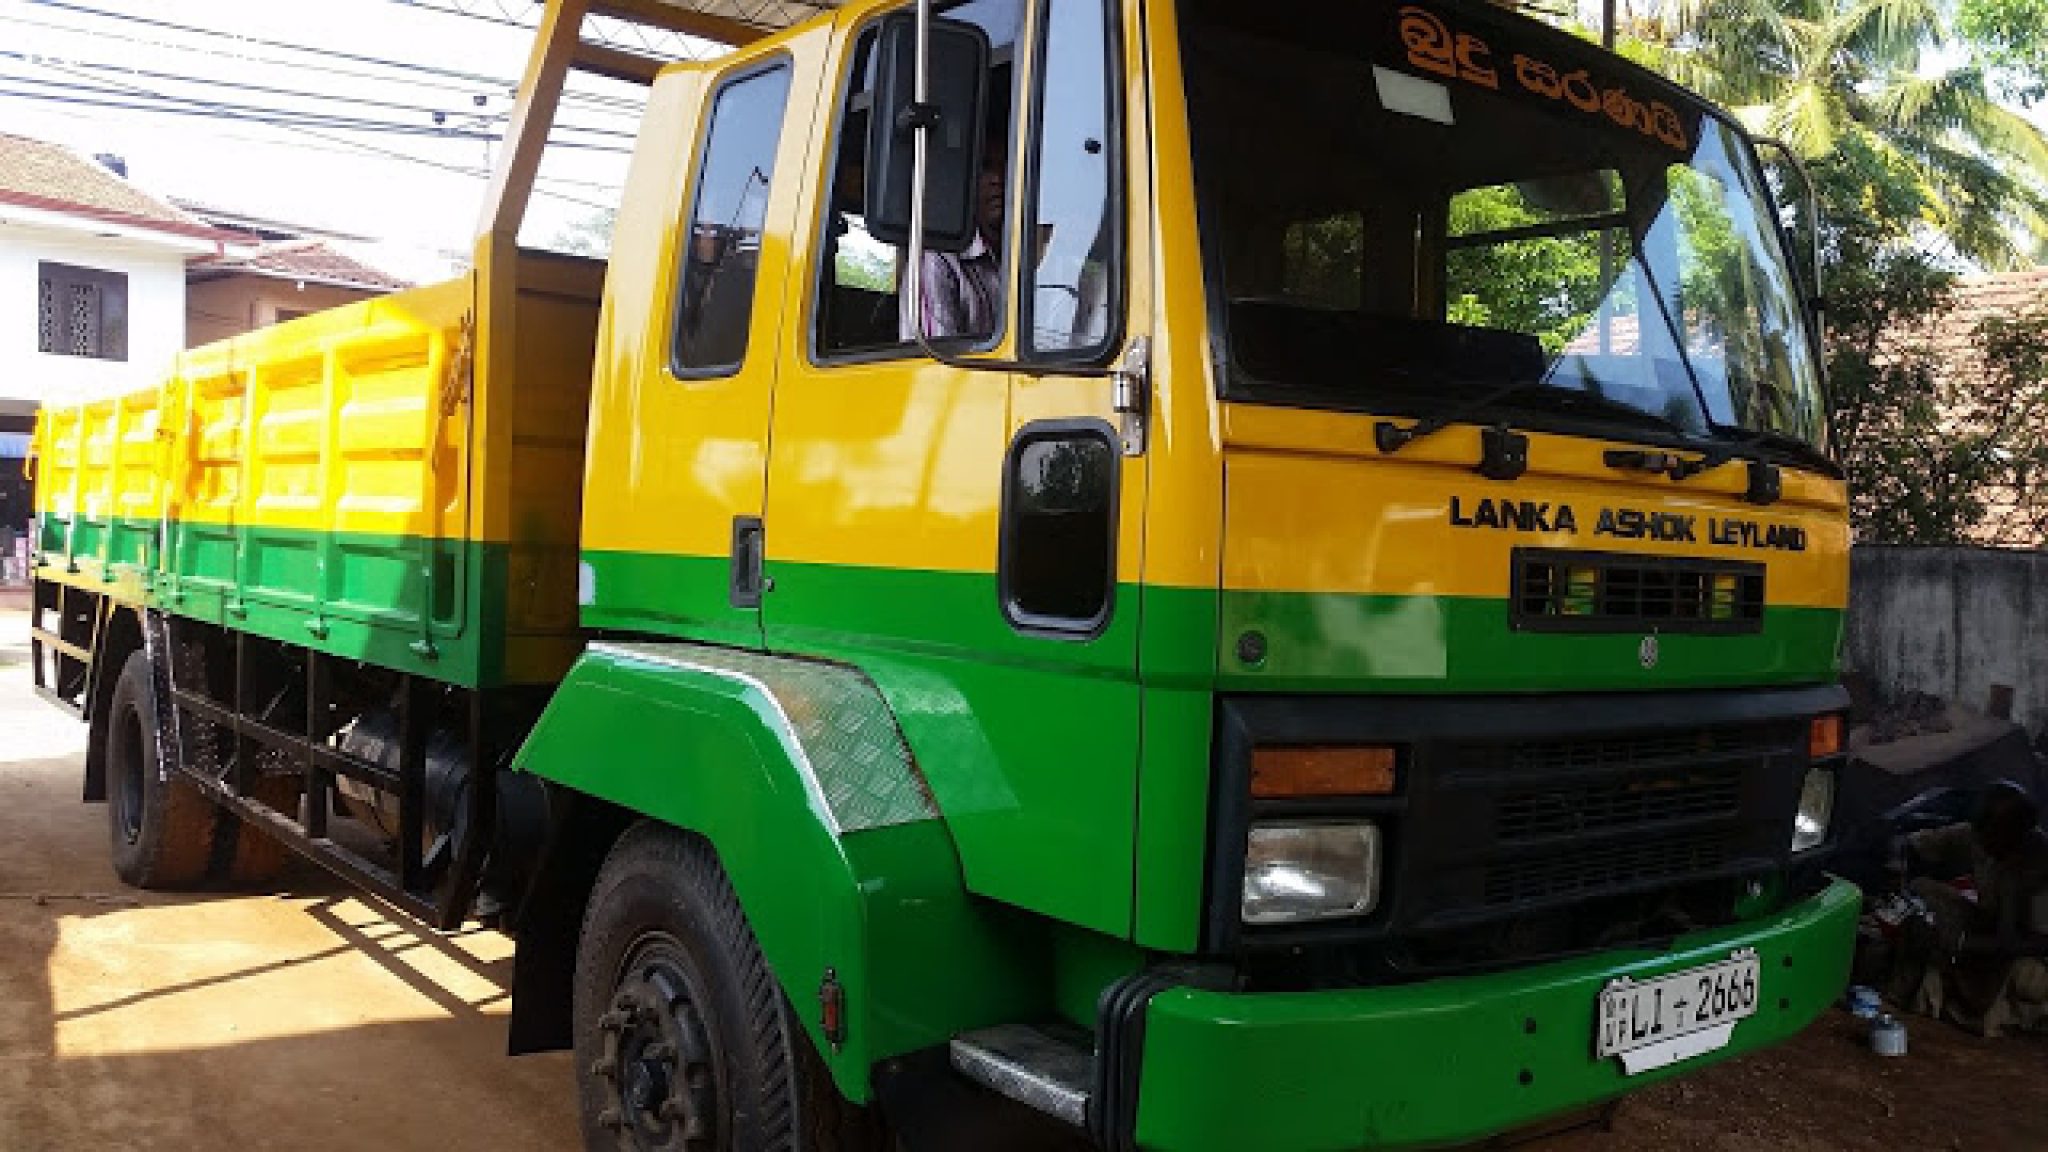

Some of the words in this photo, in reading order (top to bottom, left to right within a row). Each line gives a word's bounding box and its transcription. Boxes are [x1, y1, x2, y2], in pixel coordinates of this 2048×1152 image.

[1450, 496, 1577, 534] LANKA
[1594, 508, 1697, 543] ASHOK
[1709, 517, 1807, 550] LEYLAND
